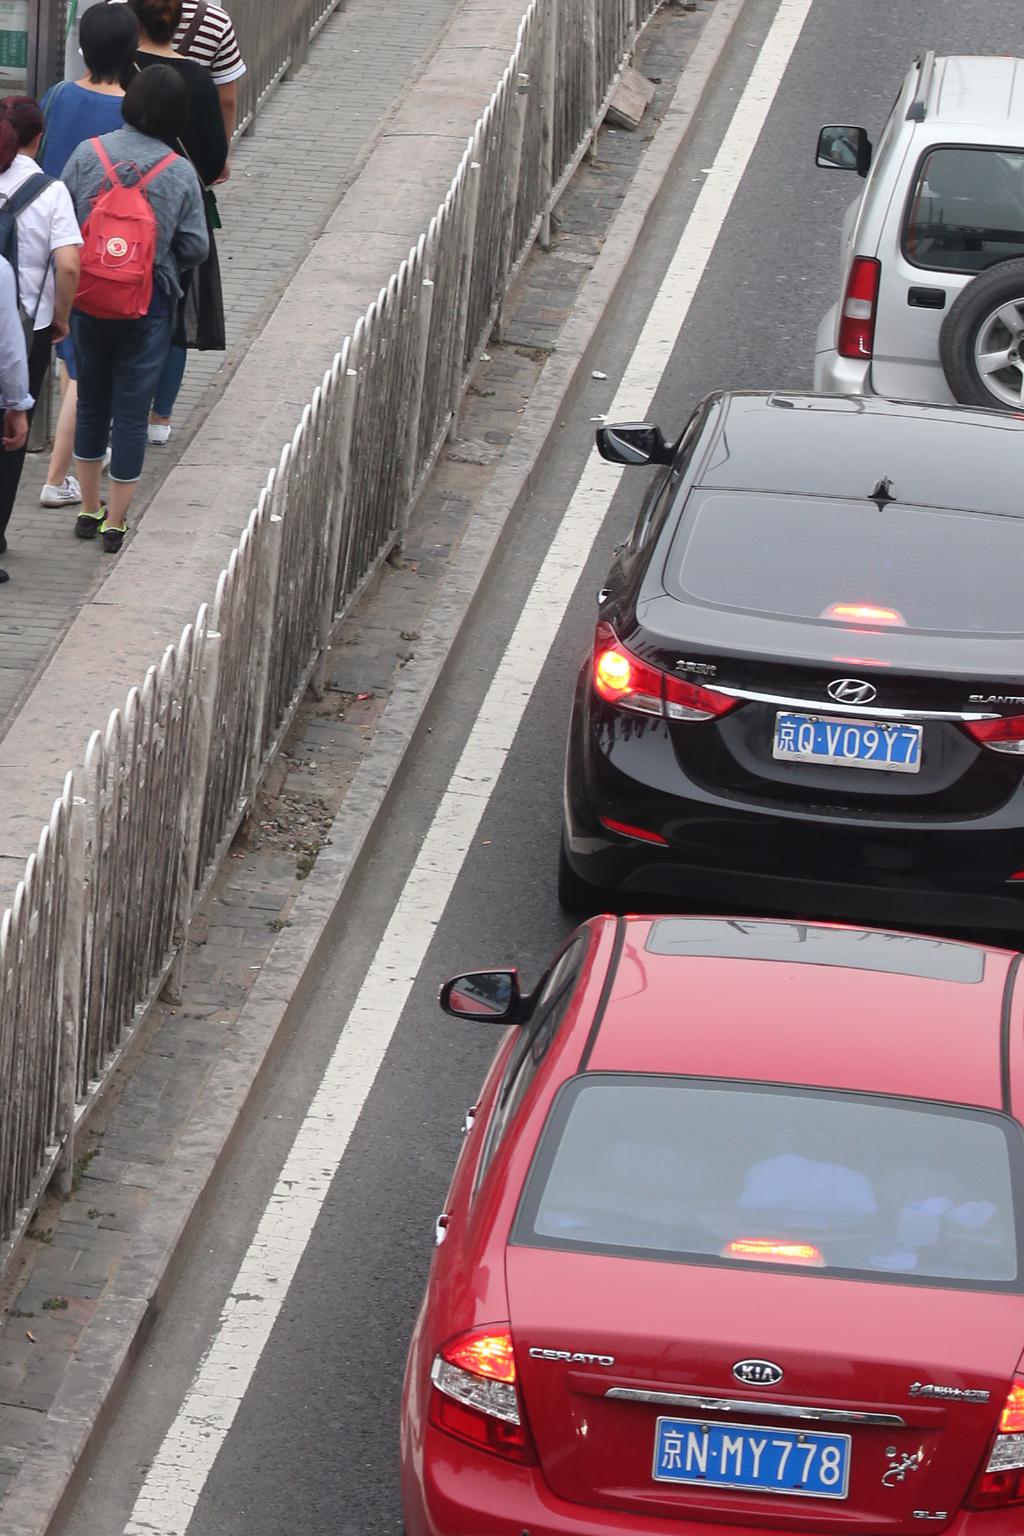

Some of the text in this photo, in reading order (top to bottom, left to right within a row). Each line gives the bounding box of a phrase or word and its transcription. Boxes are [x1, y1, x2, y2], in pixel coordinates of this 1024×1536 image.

[529, 1347, 615, 1367] CERATO
[742, 1365, 775, 1381] KIA
[661, 1428, 842, 1487] 京N·MY778
[912, 1510, 948, 1520] GLS
